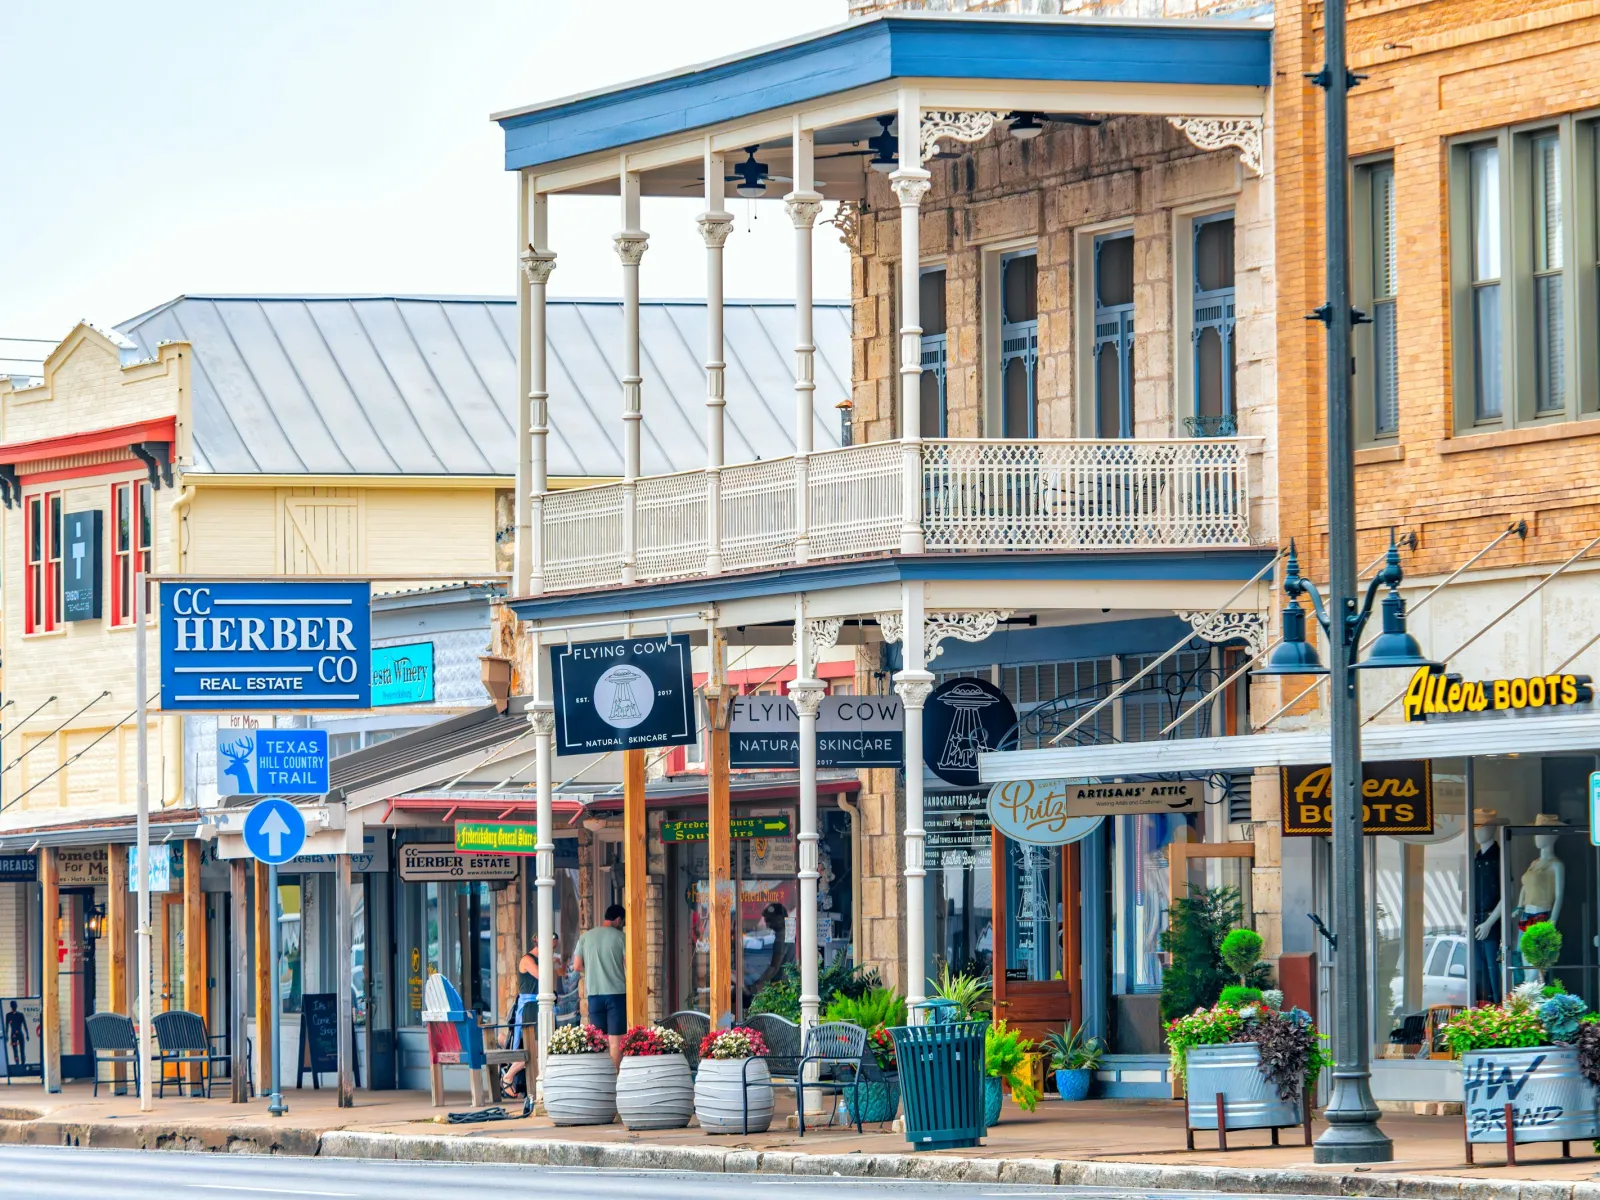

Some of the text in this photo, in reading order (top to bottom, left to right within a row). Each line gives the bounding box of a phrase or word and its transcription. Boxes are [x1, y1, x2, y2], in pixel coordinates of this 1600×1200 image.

[173, 588, 211, 615] CC
[174, 617, 357, 651] HERBER
[574, 641, 668, 660] FLYING COW
[318, 655, 358, 683] CO
[200, 677, 303, 690] REAL ESTATE
[1403, 665, 1578, 722] Allens BOOTS
[837, 703, 898, 721] COW
[230, 715, 240, 728] For
[586, 733, 668, 748] NATURAL SKINCARE
[739, 739, 892, 751] NATURA SKINCARE
[266, 741, 318, 754] TEXAS
[260, 756, 325, 769] HILL COUNTRY
[268, 772, 317, 784] TRAIL
[1294, 766, 1419, 803] Aens
[1151, 786, 1187, 796] ATTIC
[924, 796, 967, 807] HANDCRAFTED
[405, 848, 418, 856] CC
[405, 856, 464, 868] HERBER
[470, 858, 511, 868] ESTATE
[65, 862, 108, 876] For Me
[450, 867, 464, 876] CO
